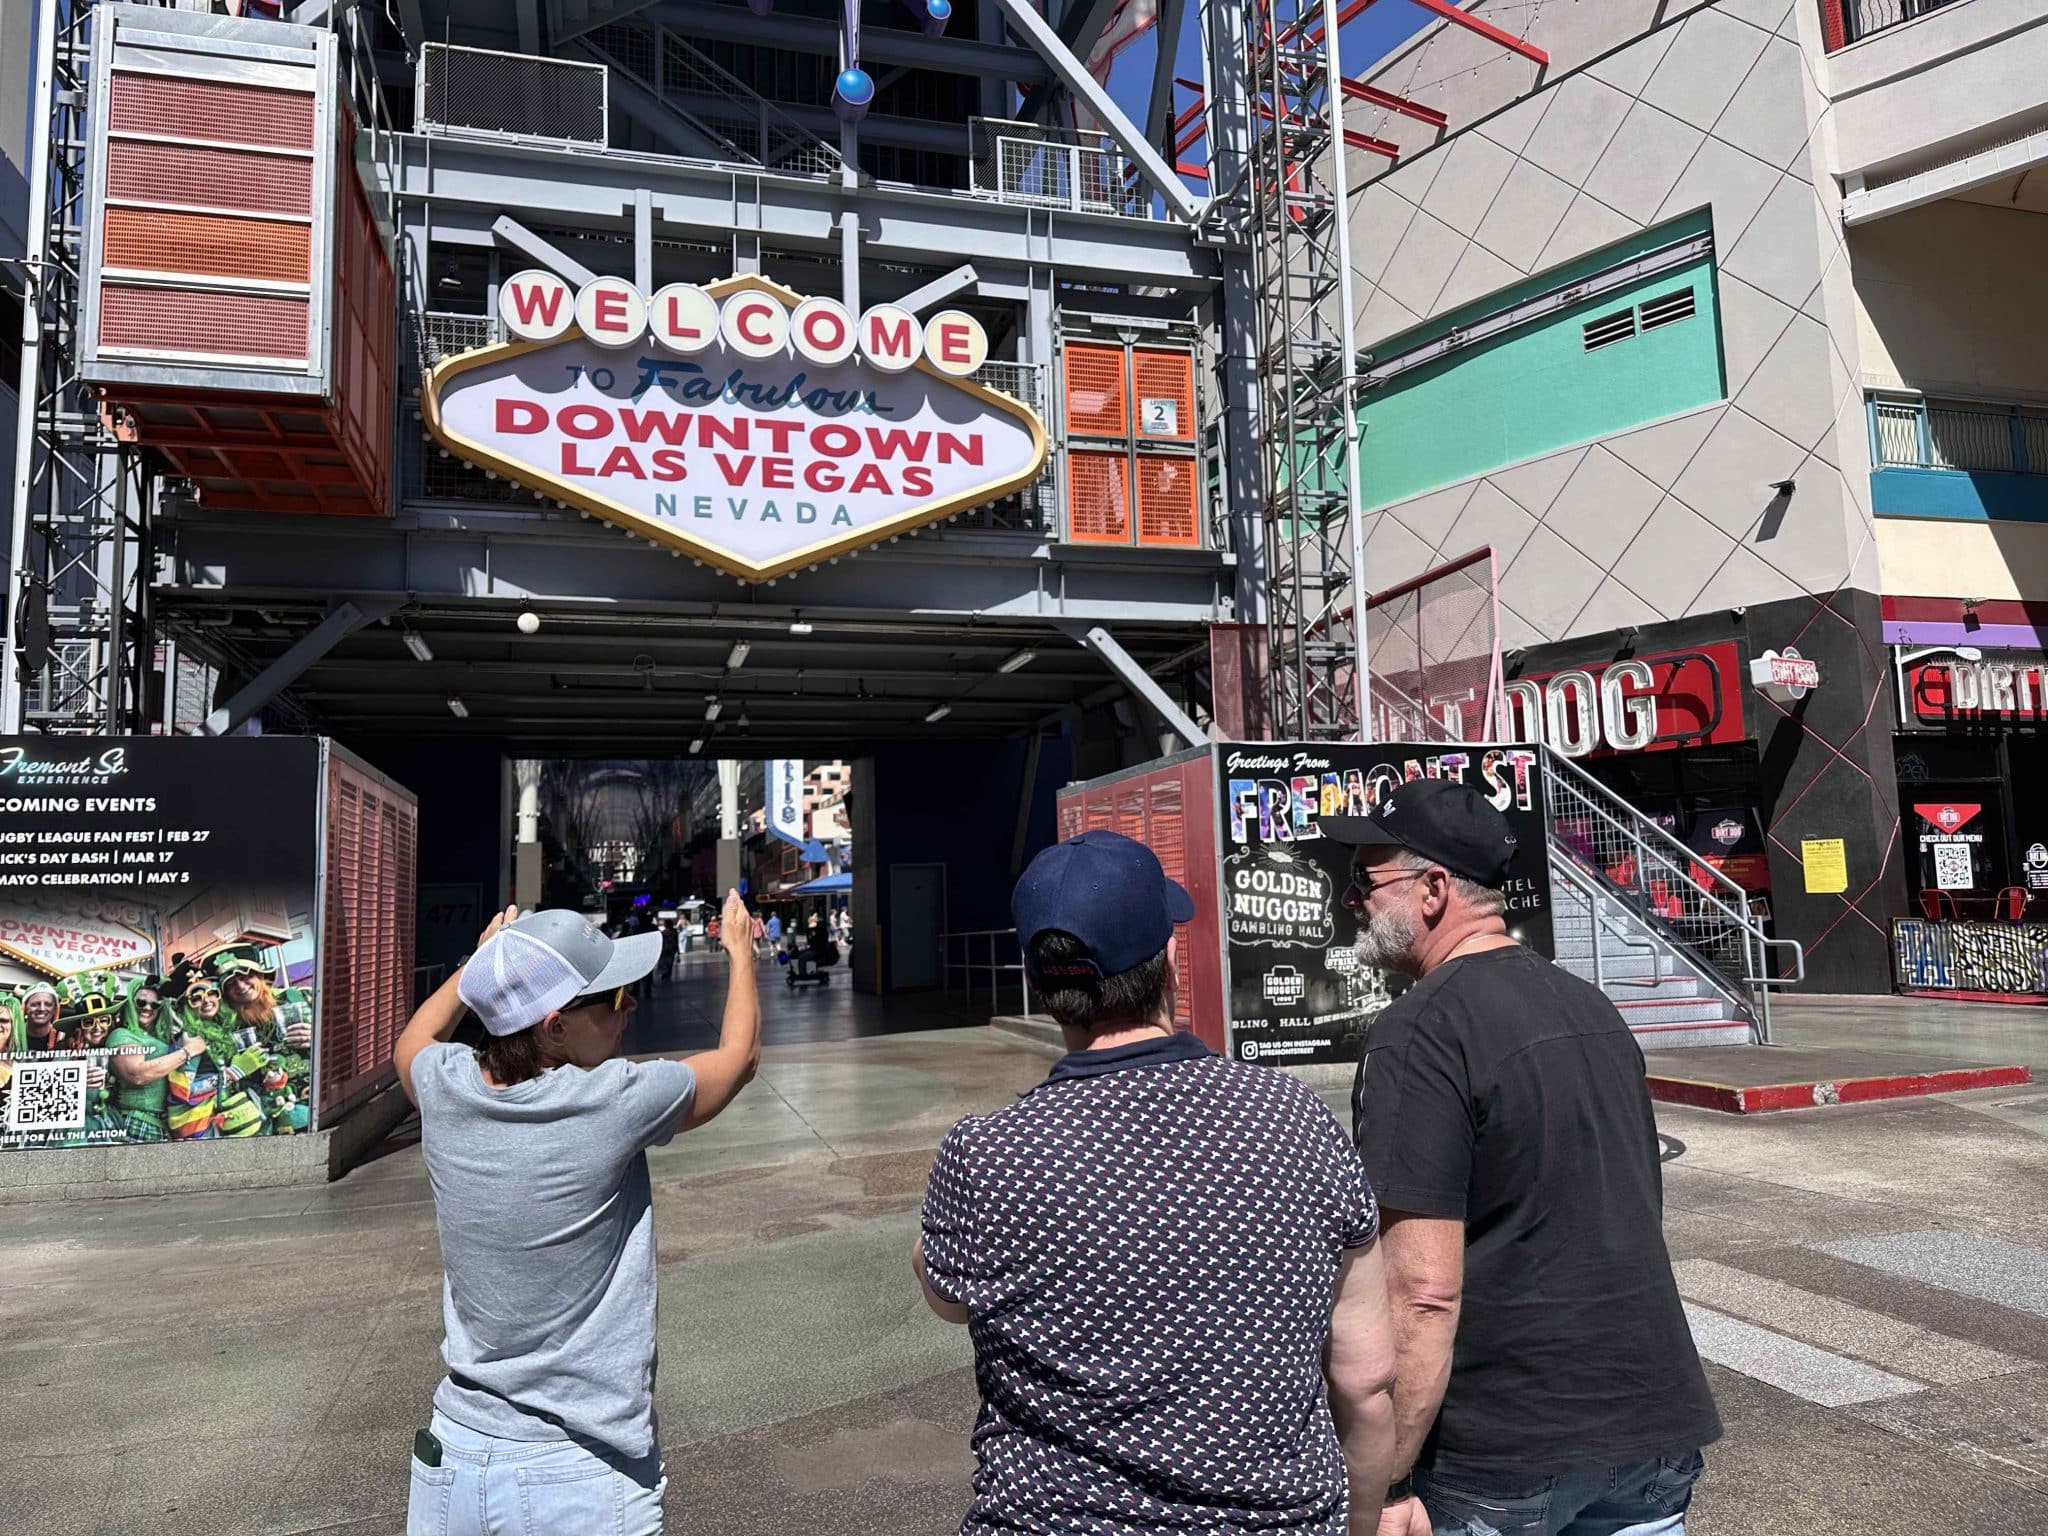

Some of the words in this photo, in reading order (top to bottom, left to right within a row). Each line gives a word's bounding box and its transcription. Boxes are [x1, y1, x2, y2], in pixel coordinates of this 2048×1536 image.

[510, 283, 973, 364] WELCOME
[566, 364, 615, 391] TO
[631, 358, 894, 415] Fabulous
[1154, 405, 1165, 421] 2
[495, 397, 985, 467] DOWNTOWN
[560, 441, 687, 482] LAS
[712, 453, 934, 498] VEGAS
[655, 493, 853, 527] NEVADA
[1949, 662, 2037, 711] DIRT
[1497, 660, 1657, 757] DOG
[0, 747, 91, 775] Fremont
[93, 747, 129, 775] St.
[1226, 751, 1290, 774] Greetings
[1293, 752, 1330, 771] From
[17, 776, 109, 784] EXPERIENCE
[1481, 749, 1537, 812] ST
[85, 798, 157, 812] EVENTS
[37, 832, 91, 844] LEAGUE
[94, 832, 122, 843] FAN
[125, 831, 154, 843] FEST
[167, 831, 190, 842] FEB
[192, 830, 210, 842] 27
[40, 853, 68, 864] DAY
[71, 852, 109, 864] BASH
[122, 852, 154, 863] MAR
[159, 851, 174, 863] 17
[41, 872, 134, 885] CELEBRATION
[146, 872, 179, 884] MAY
[181, 871, 190, 883] 5
[1235, 869, 1322, 899] GOLDEN
[1501, 878, 1535, 892] TEL
[1234, 893, 1322, 922] NUGGET
[1231, 920, 1293, 936] GAMBLING
[1299, 925, 1324, 938] HALL
[0, 930, 44, 946] LAS
[52, 939, 122, 958] VEGAS
[31, 948, 97, 964] NEVADA
[1267, 986, 1301, 995] NUGGET
[1280, 1018, 1311, 1028] HALL
[1294, 1039, 1332, 1047] INSTAGRAM
[10, 1051, 34, 1060] FULL
[36, 1048, 119, 1059] ENTERTAINMENT
[121, 1046, 157, 1056] LINEUP
[24, 1133, 45, 1142] FOR
[47, 1131, 65, 1141] ALL
[67, 1130, 87, 1140] THE
[88, 1128, 127, 1139] ACTION
